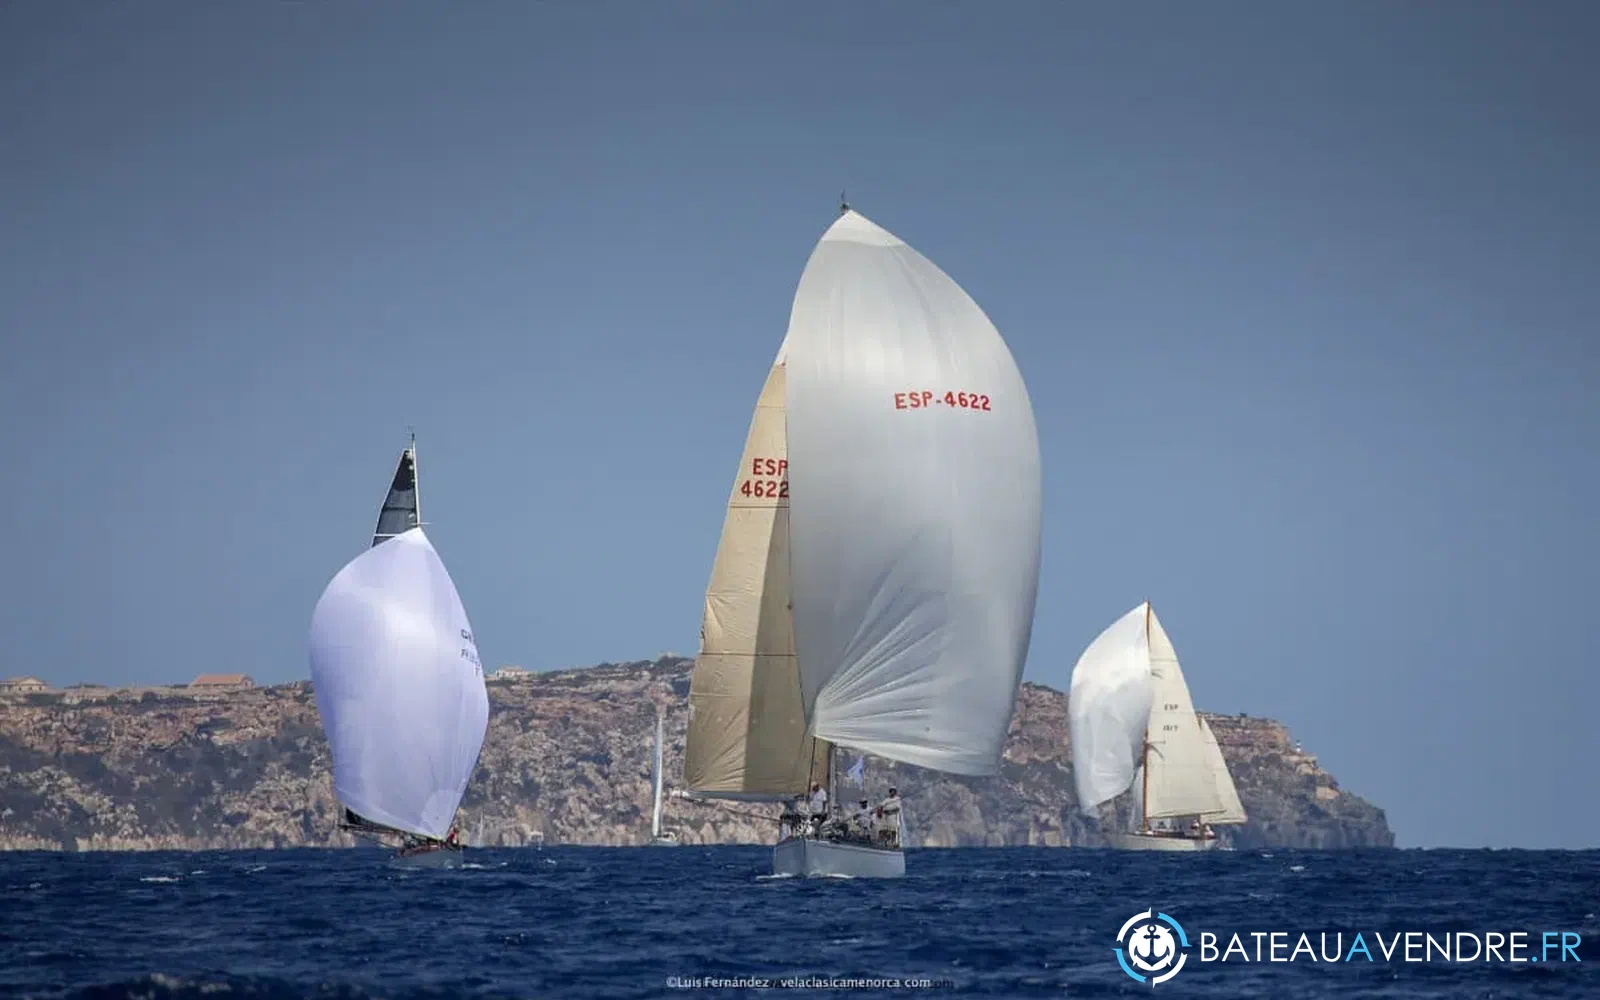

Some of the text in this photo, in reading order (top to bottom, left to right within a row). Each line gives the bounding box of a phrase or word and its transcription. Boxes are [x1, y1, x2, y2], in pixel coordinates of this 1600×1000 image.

[894, 391, 991, 411] ESP-4622
[752, 458, 788, 476] ESP
[741, 480, 789, 498] 4622
